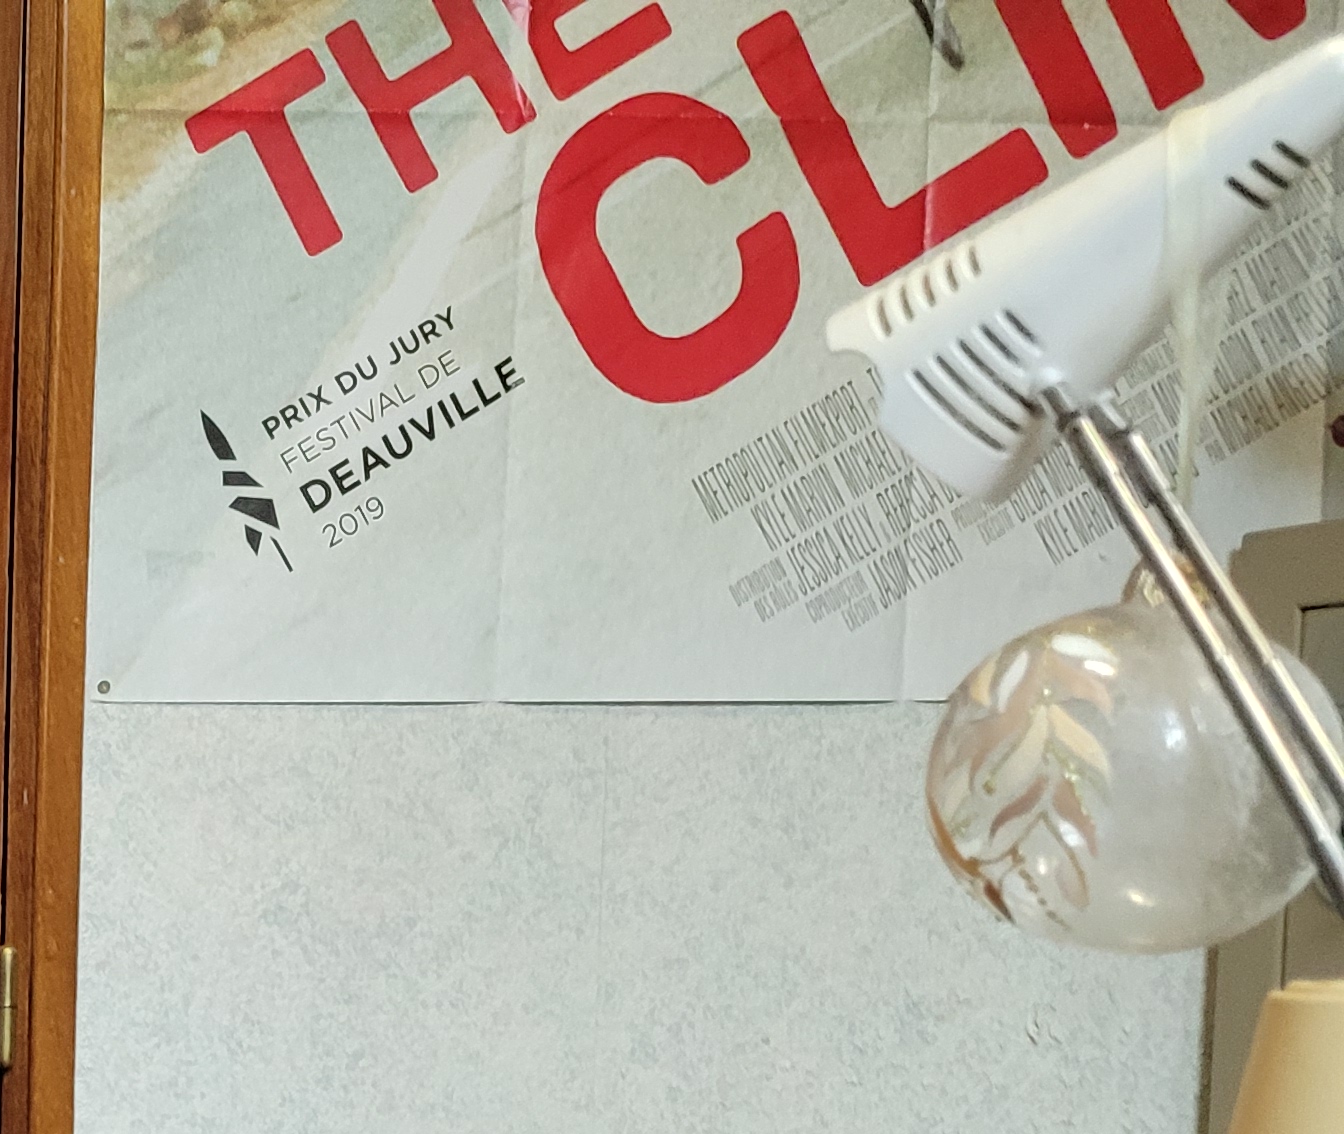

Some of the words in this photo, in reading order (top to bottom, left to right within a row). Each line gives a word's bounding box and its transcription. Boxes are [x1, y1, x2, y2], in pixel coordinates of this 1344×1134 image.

[184, 0, 672, 257] THE
[261, 385, 333, 440] PRIX
[334, 355, 378, 396] DU
[389, 305, 457, 366] JURY
[280, 384, 416, 474] FESTIVAL
[417, 349, 462, 389] DE
[299, 356, 526, 514] DEAUVILLE
[692, 426, 799, 523] METROPOLITAN
[751, 494, 796, 552] KYLE
[780, 463, 846, 533] MARVIN
[834, 427, 901, 499] MICHAEL
[321, 496, 384, 548] 2019
[786, 525, 849, 597] JESSICA
[832, 503, 882, 566] KELLY
[902, 518, 964, 584] FISHER
[1033, 509, 1078, 567] KYLE
